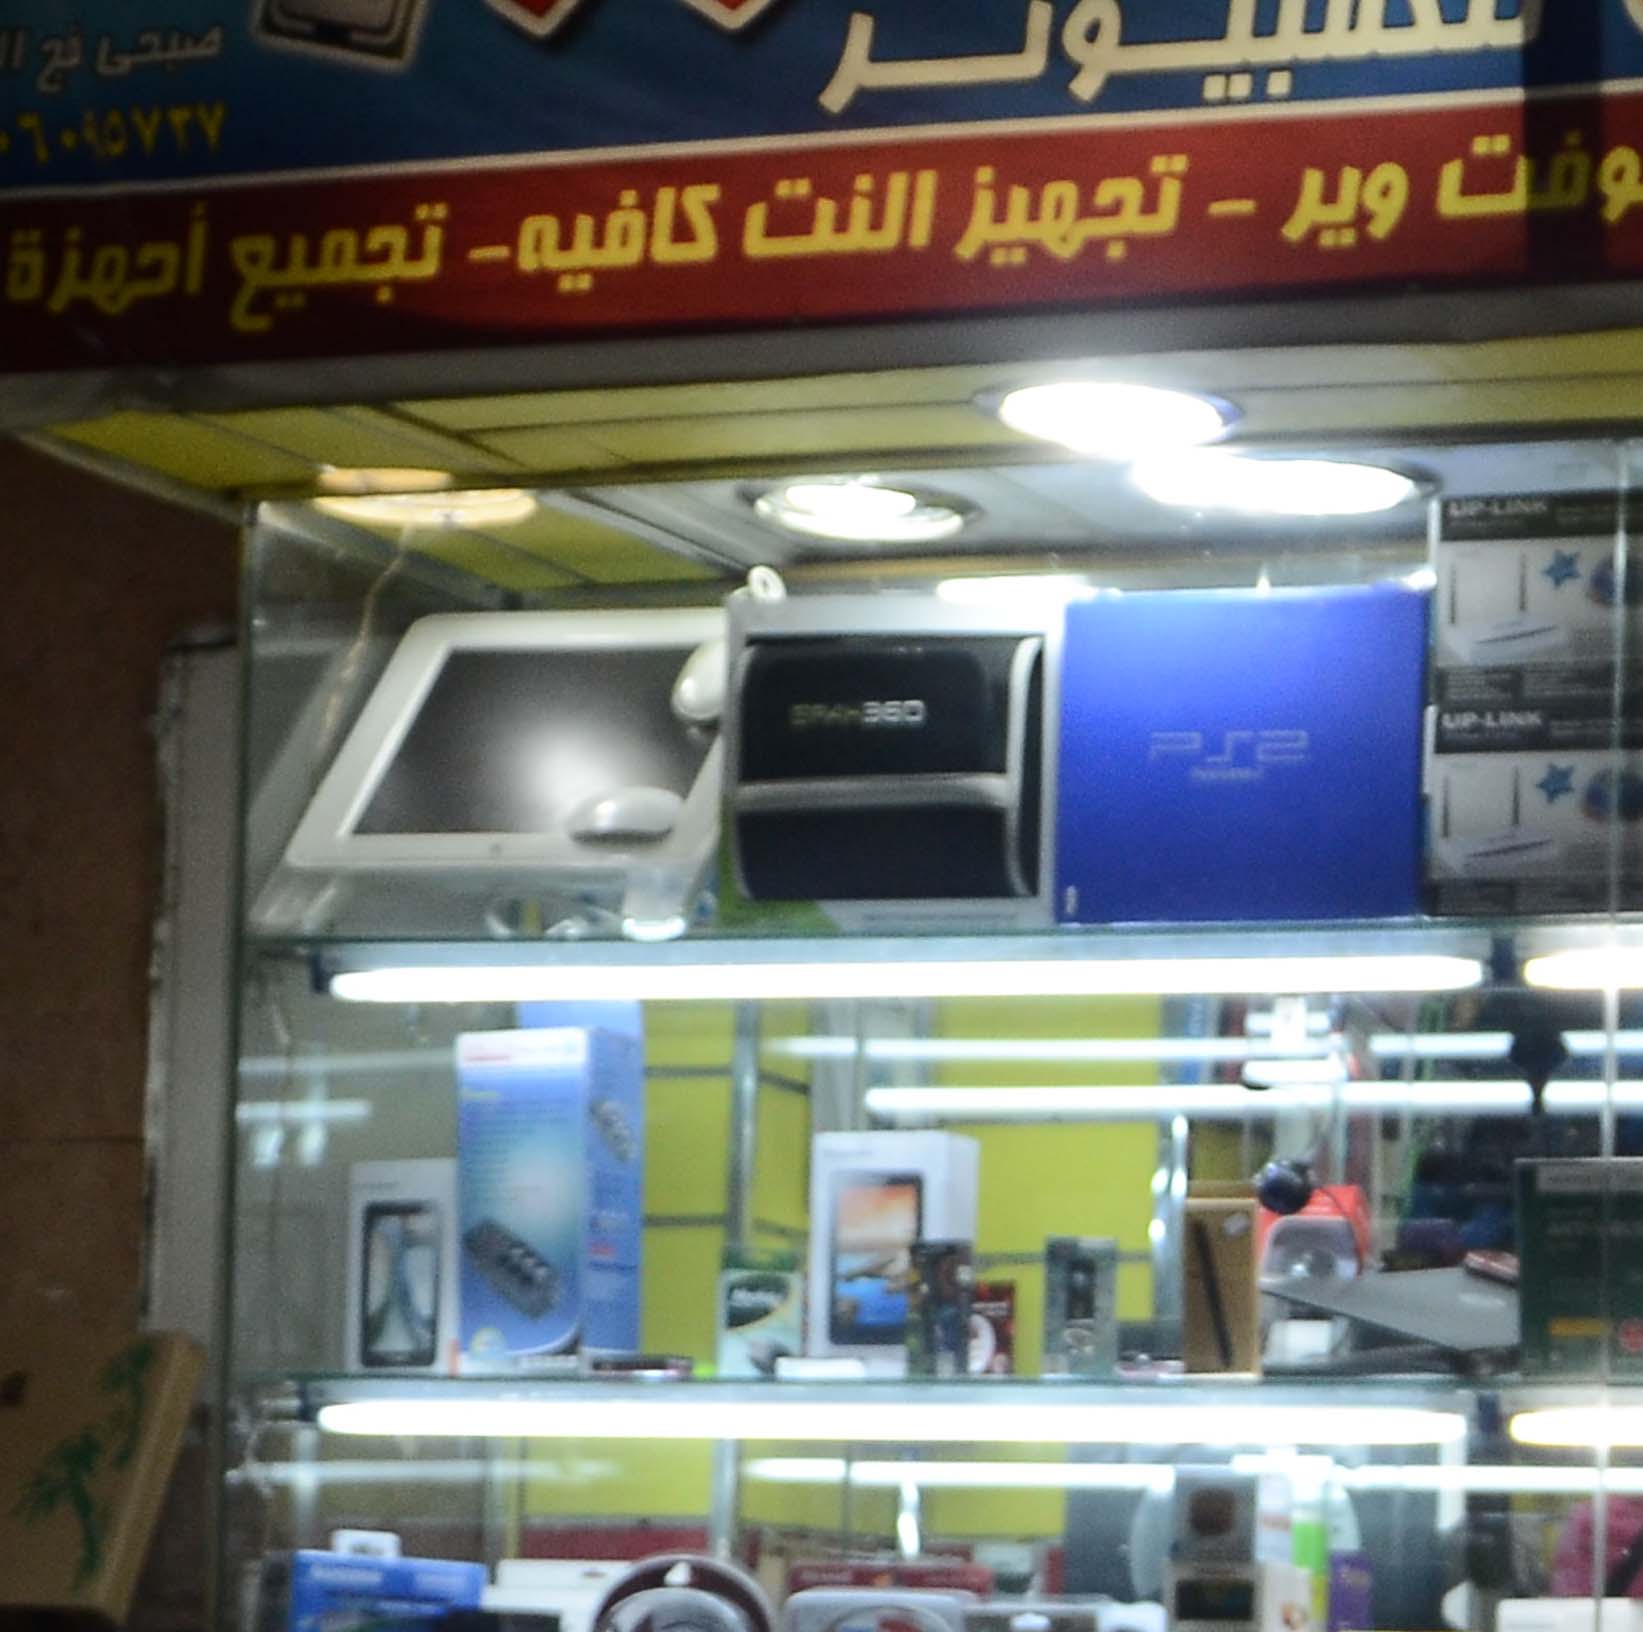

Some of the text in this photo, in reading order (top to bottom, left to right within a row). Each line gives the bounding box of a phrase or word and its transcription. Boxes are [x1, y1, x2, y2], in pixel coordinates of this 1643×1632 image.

[516, 182, 721, 294] كافيه
[741, 167, 938, 259] النت
[952, 153, 1190, 266] تجهيز
[1280, 160, 1410, 249] وير
[228, 201, 449, 334] تجميع
[1148, 729, 1310, 782] PS2
